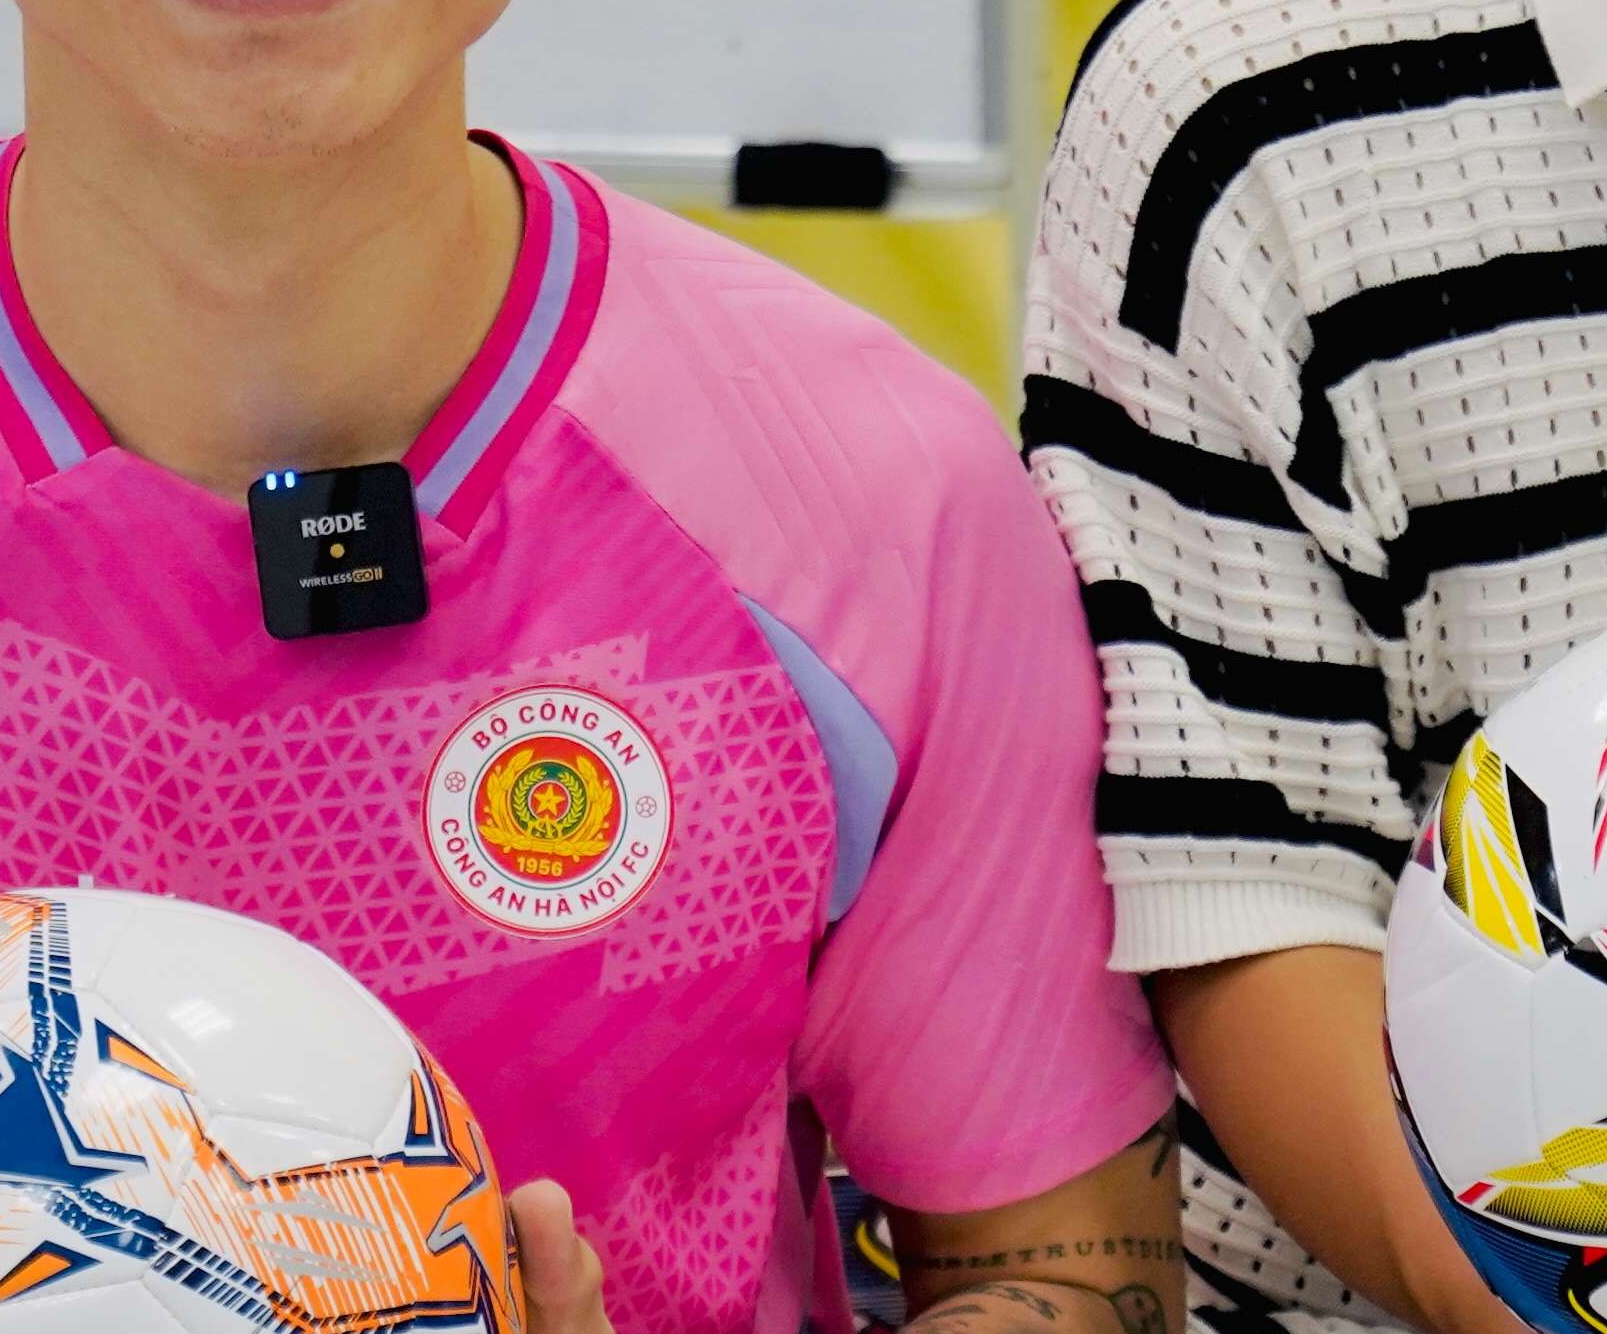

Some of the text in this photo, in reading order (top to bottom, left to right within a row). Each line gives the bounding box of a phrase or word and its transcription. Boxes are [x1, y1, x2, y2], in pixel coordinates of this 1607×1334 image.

[300, 512, 367, 538] RØDE
[471, 698, 640, 766] BỘ CÔNG AN
[440, 818, 650, 917] CÔNG AN HÀ NỘI FC
[516, 856, 564, 878] 1956
